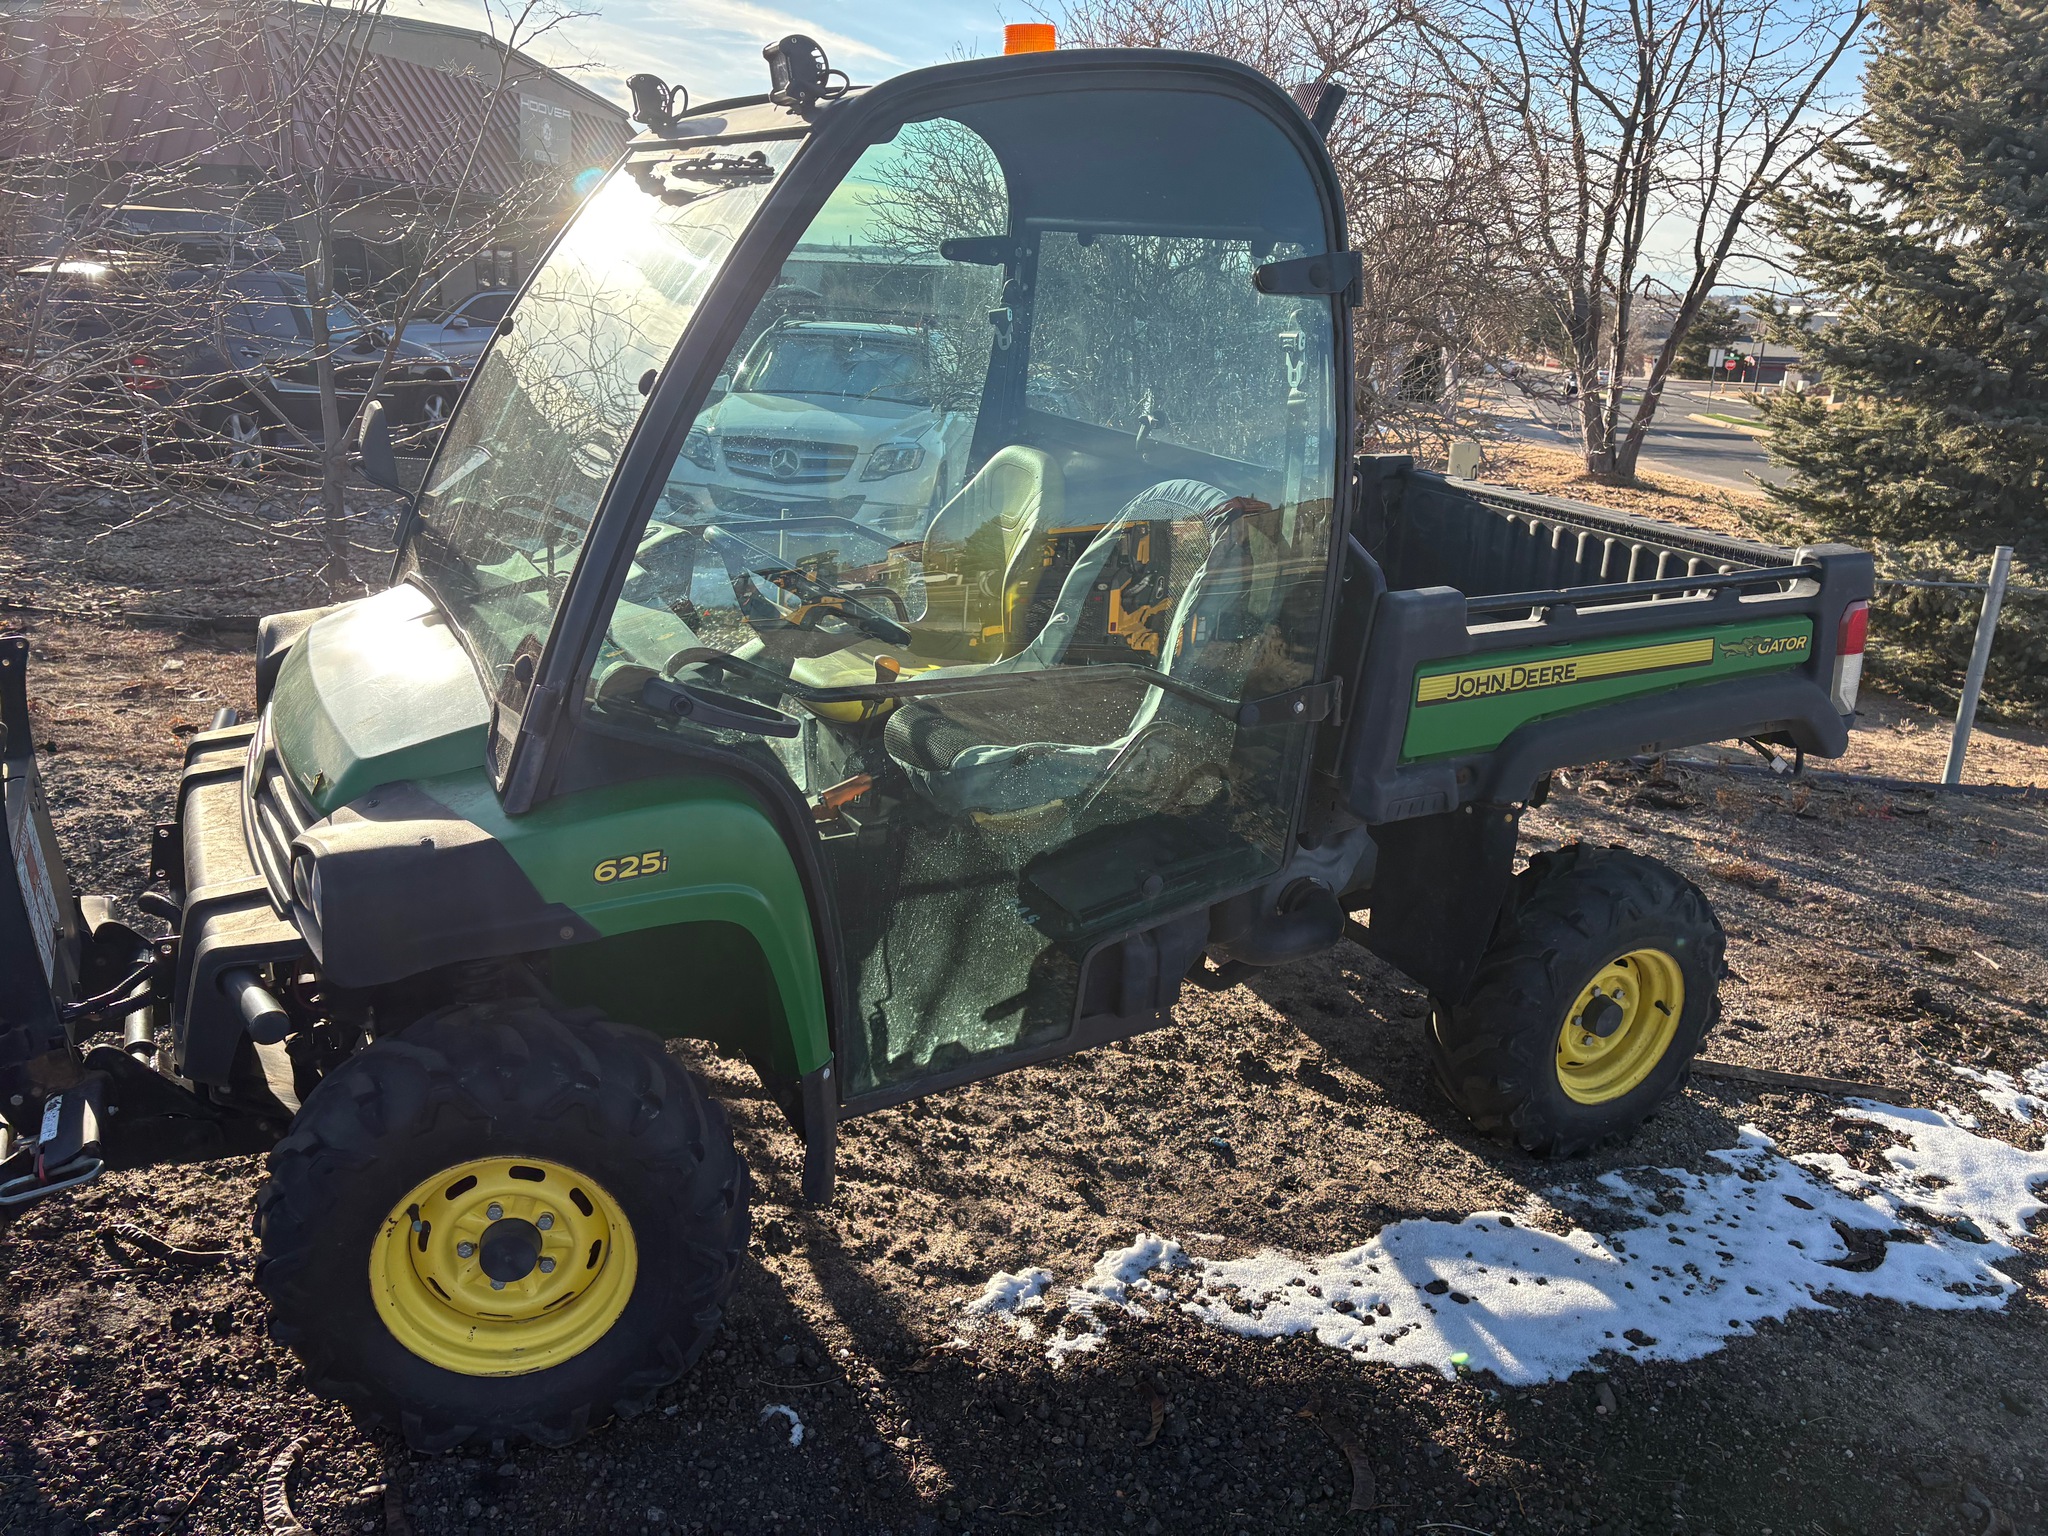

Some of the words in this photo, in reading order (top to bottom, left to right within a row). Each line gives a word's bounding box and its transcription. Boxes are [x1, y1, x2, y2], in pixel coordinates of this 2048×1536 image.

[520, 97, 571, 120] HOOVER
[1757, 635, 1808, 655] GATOR
[1446, 672, 1506, 699] JOHN
[1510, 662, 1577, 690] DEERE
[593, 850, 668, 884] 625i
